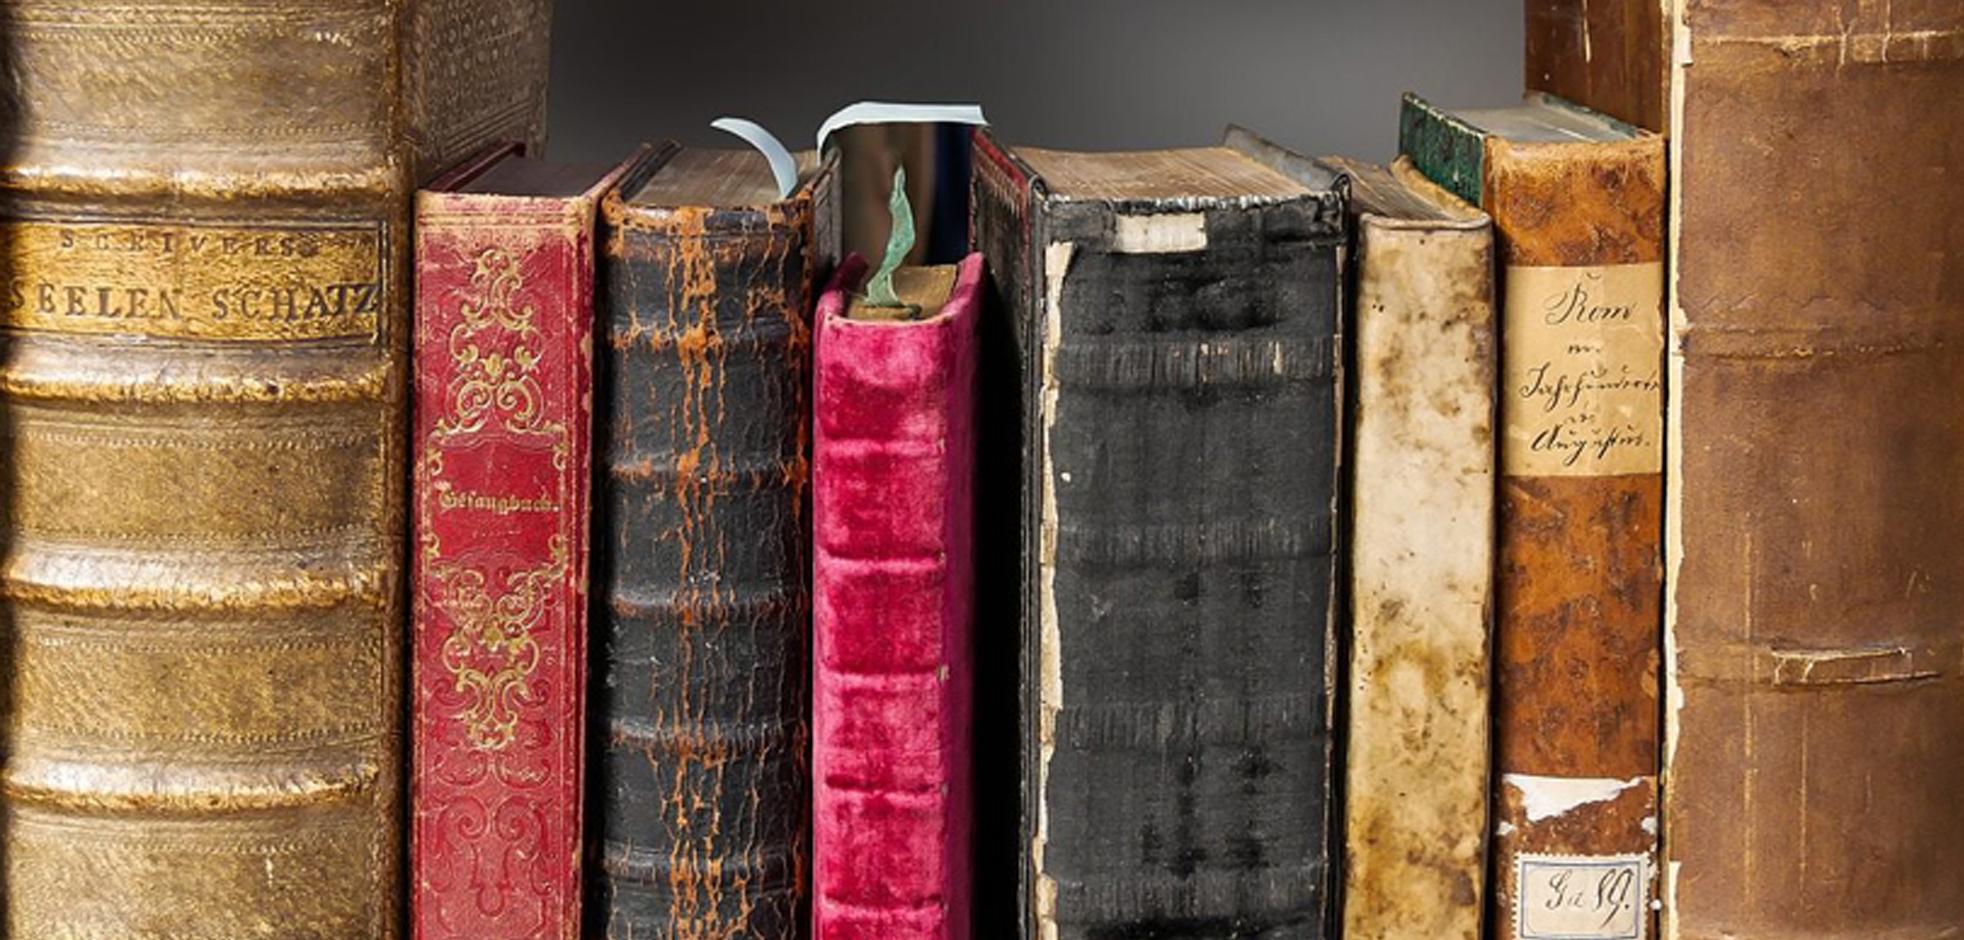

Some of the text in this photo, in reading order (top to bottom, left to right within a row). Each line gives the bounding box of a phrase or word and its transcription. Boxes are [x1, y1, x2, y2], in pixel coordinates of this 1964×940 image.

[9, 278, 378, 323] SEELEN SCHATZ
[1545, 273, 1636, 325] Rom
